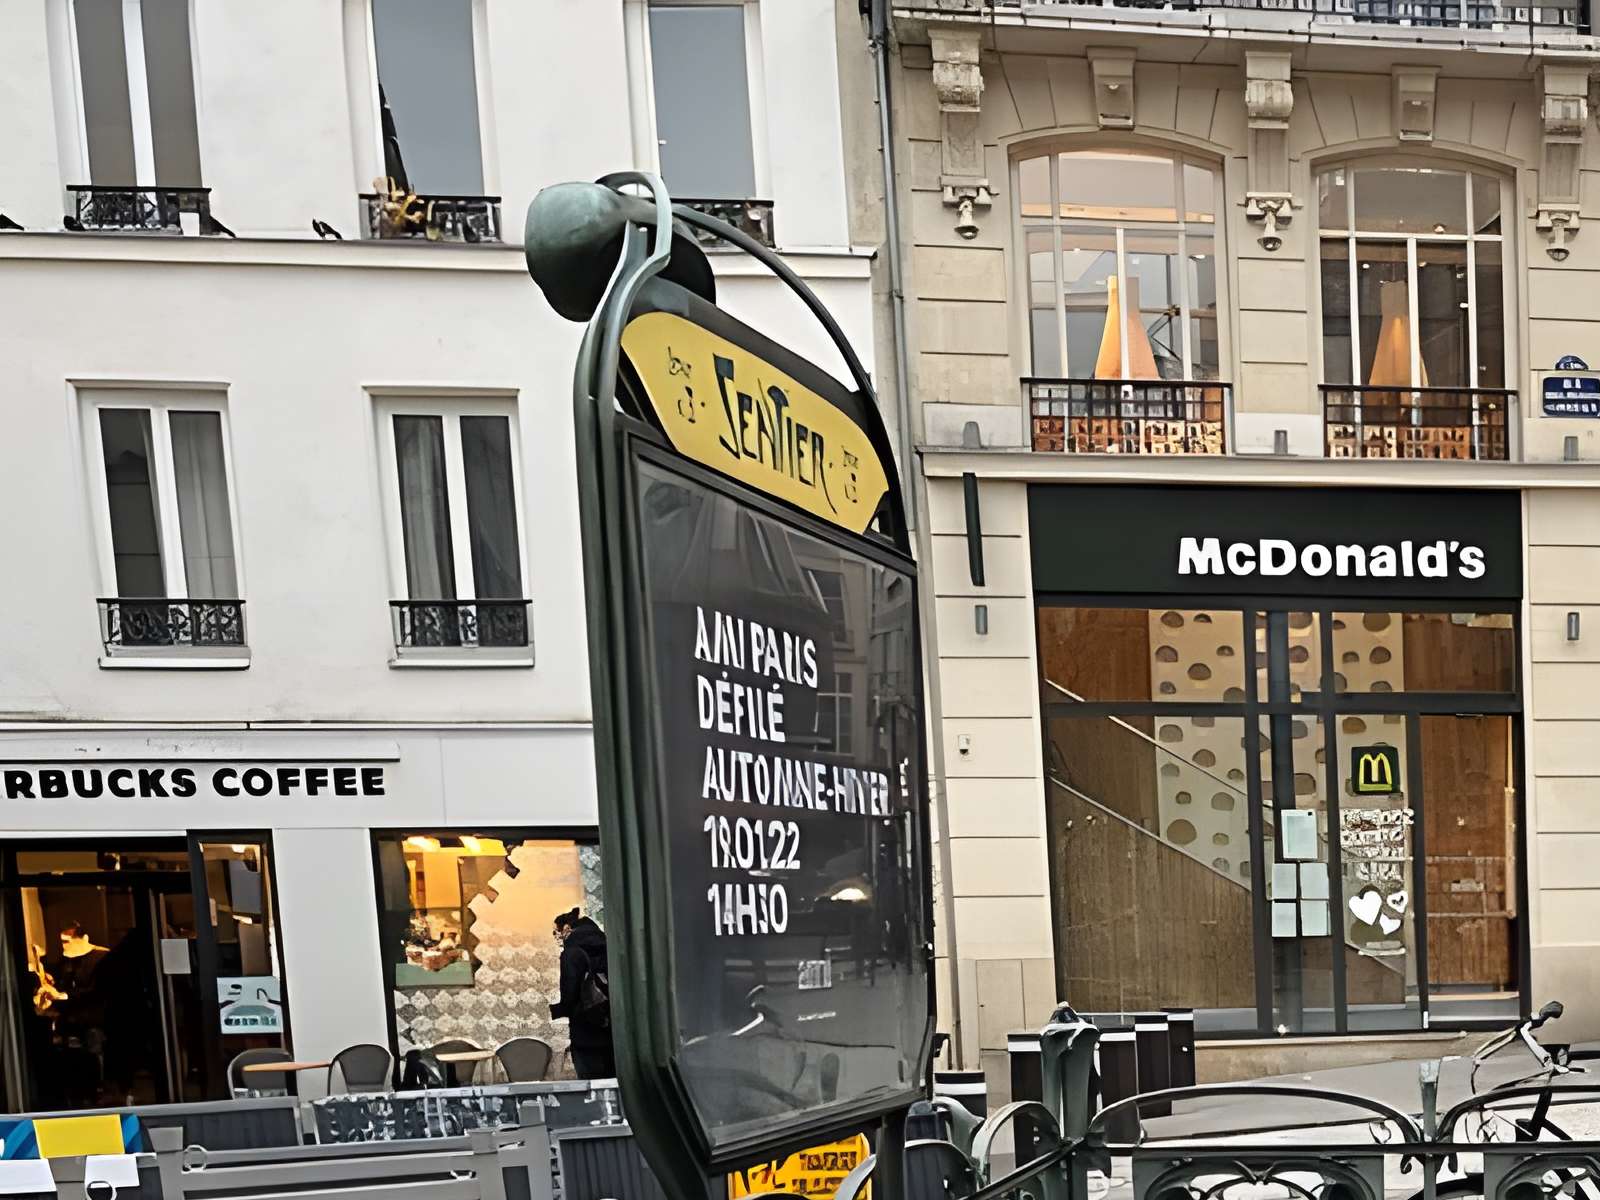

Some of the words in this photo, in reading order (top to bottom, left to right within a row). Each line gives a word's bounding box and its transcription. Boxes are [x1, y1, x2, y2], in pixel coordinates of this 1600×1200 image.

[1178, 538, 1485, 579] McDonald's
[3, 767, 196, 799] RBUCKS
[212, 768, 385, 797] COFFEE
